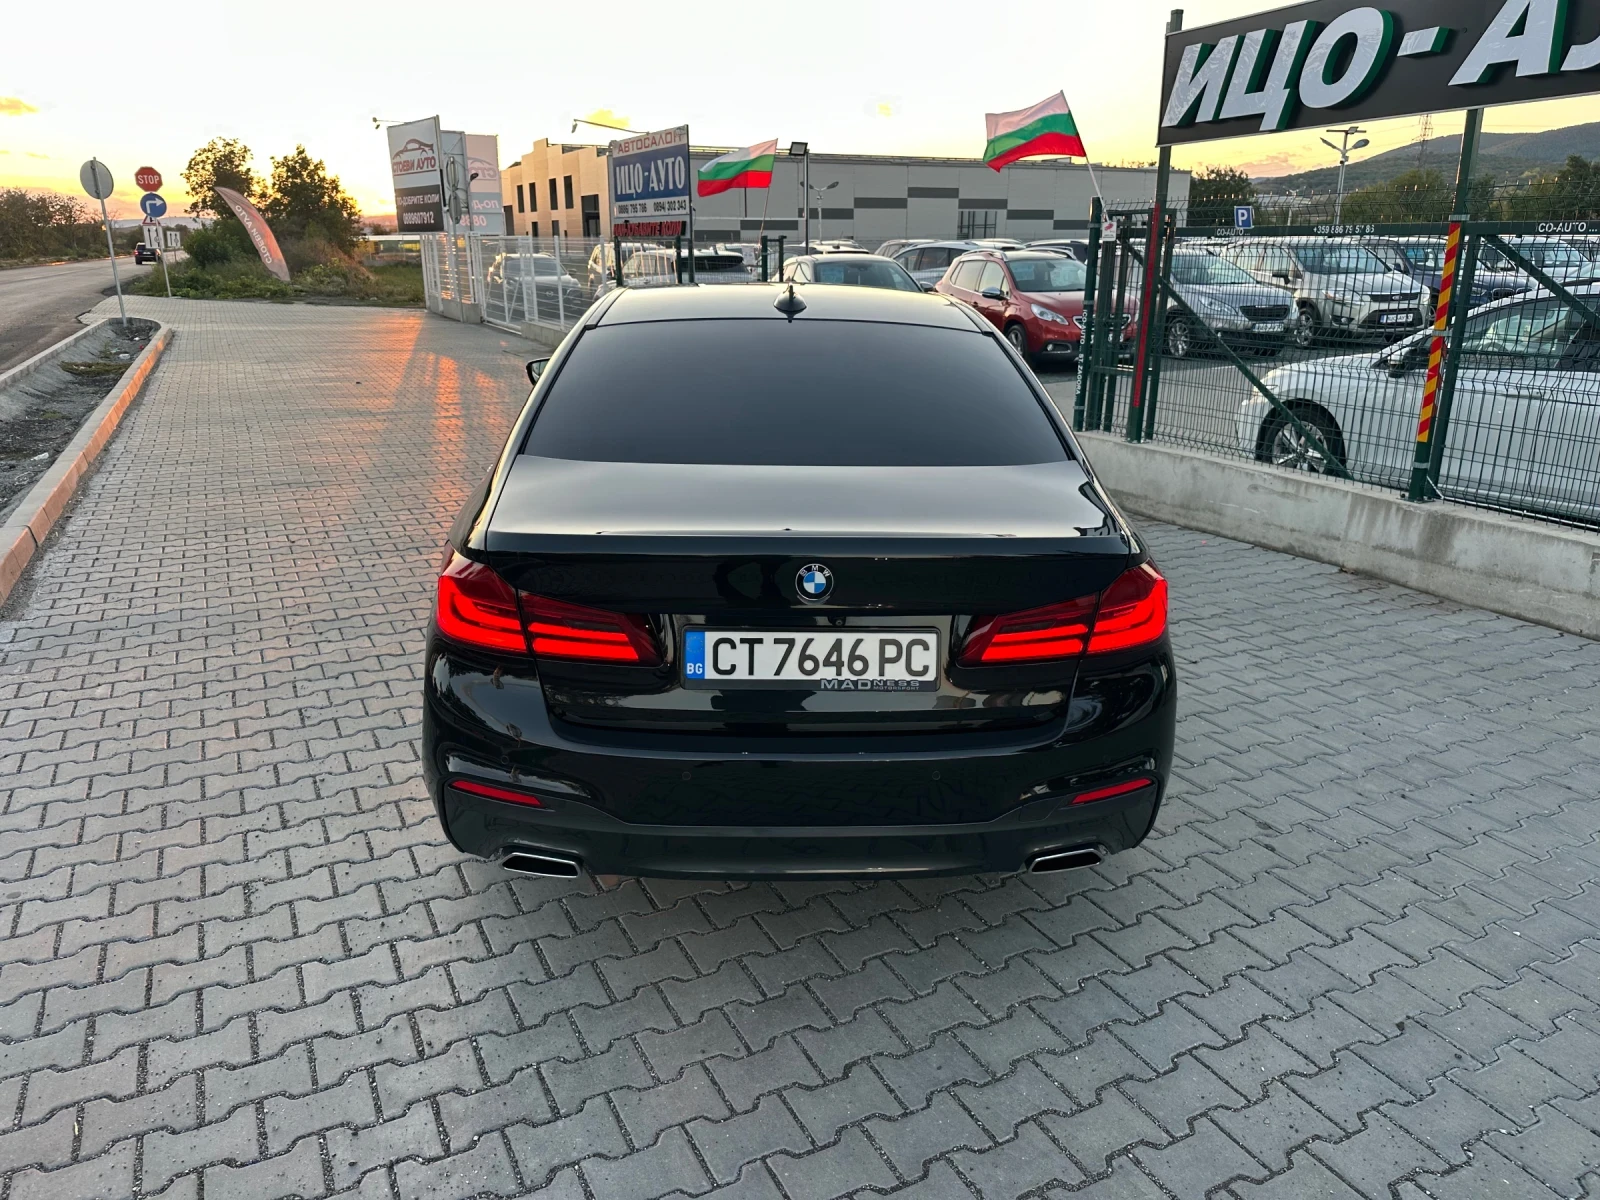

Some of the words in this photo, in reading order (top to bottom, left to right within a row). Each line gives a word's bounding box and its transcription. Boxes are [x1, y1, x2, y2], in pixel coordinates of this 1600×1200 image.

[617, 131, 682, 154] АВТОСАЛОН
[393, 158, 416, 173] СТОЕВИ
[416, 155, 436, 171] АУТО
[137, 175, 160, 185] STOP
[616, 156, 685, 198] ИЦО-АУТО
[424, 193, 440, 204] КОЛИ
[1238, 209, 1248, 226] P
[1313, 225, 1330, 234] +359
[799, 564, 831, 577] BMW
[712, 637, 764, 676] CT
[773, 637, 869, 677] 7646
[878, 638, 930, 677] PC
[686, 663, 703, 675] BG
[820, 679, 920, 690] MADNESS
